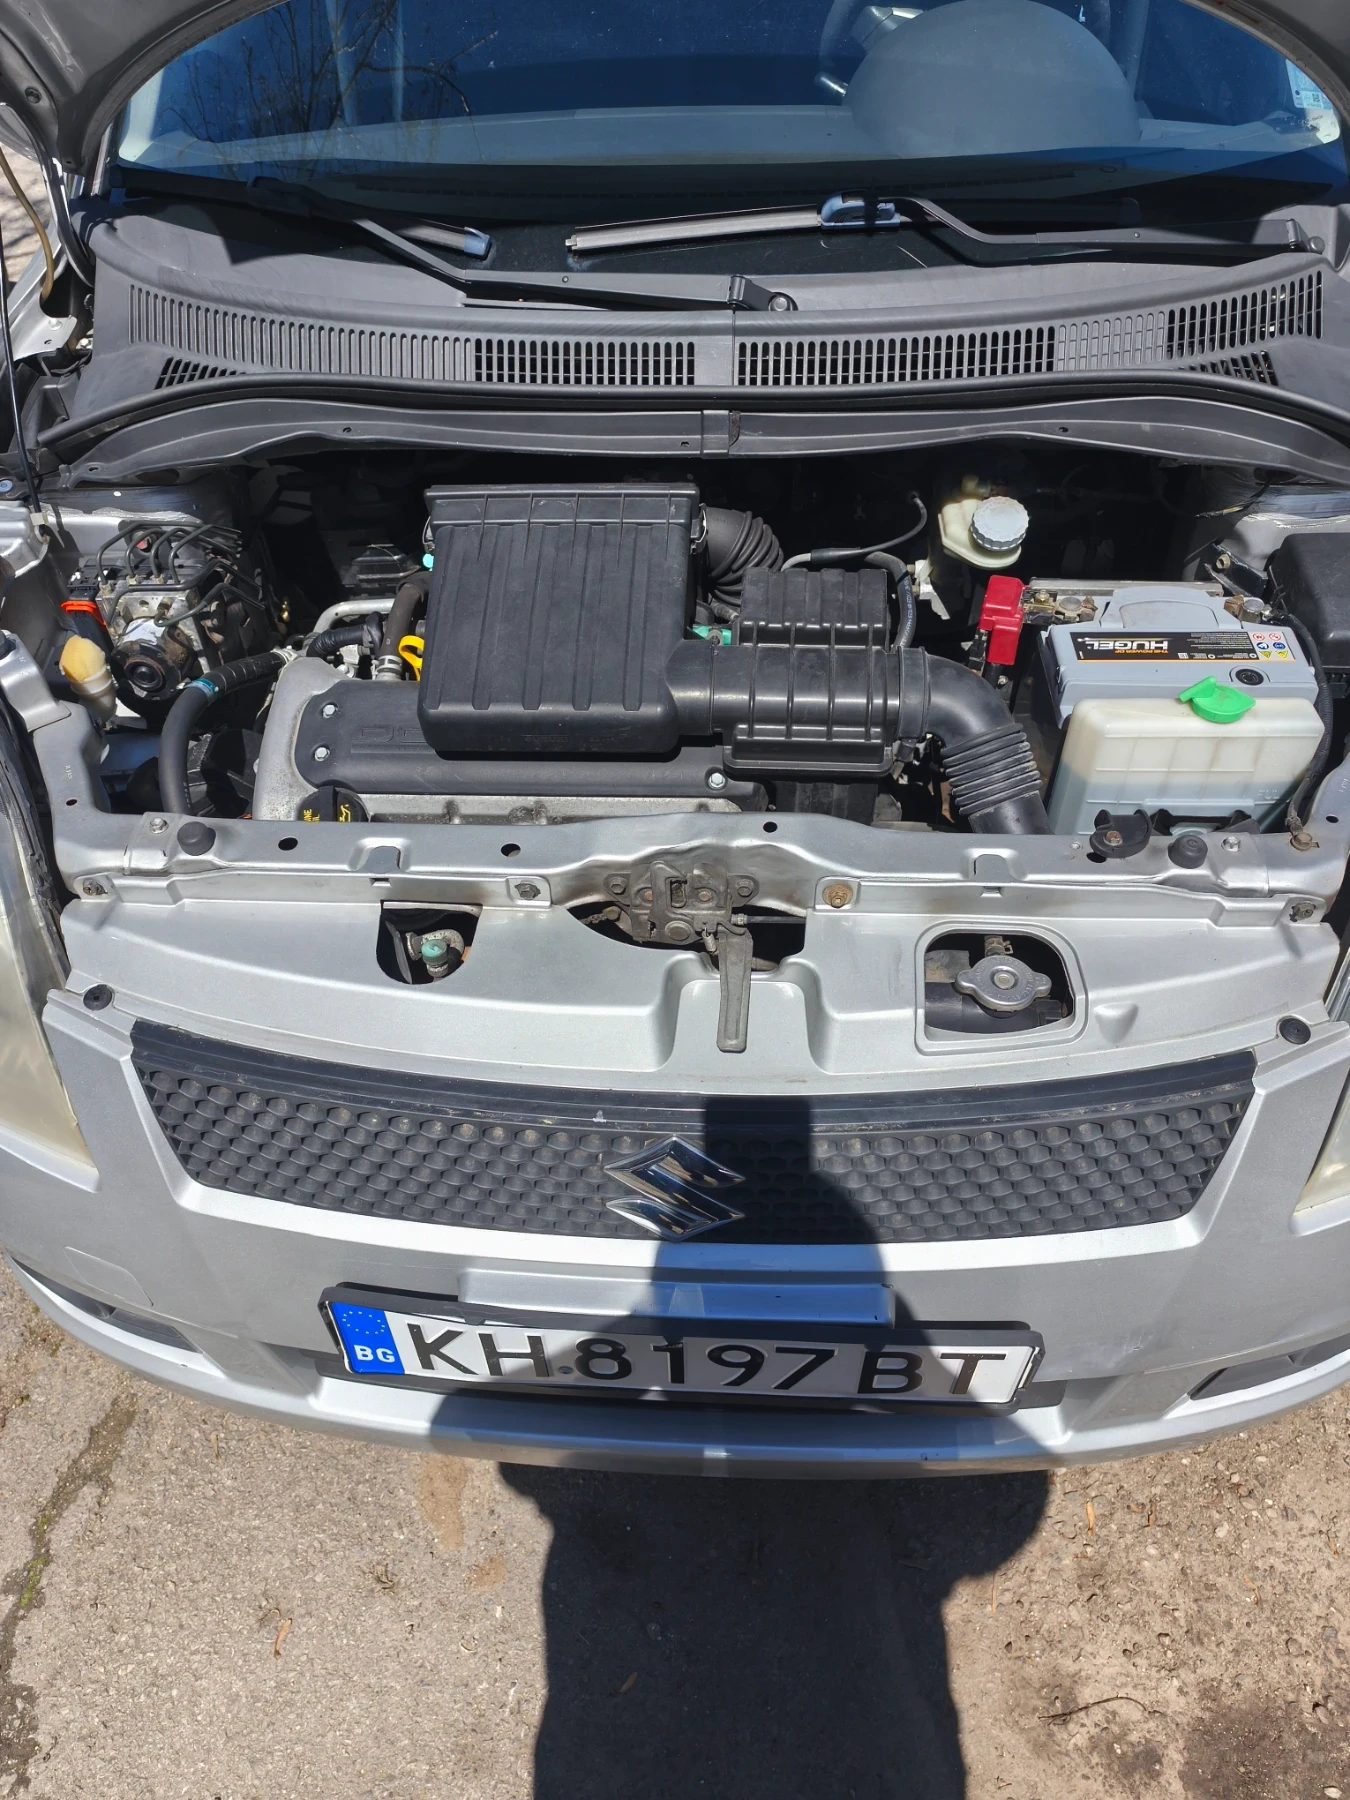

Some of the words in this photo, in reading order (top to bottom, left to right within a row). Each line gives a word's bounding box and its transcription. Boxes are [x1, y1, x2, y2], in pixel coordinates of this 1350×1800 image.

[1085, 641, 1168, 650] HUGEL
[354, 1344, 395, 1364] BG
[406, 1322, 553, 1378] KH
[574, 1337, 838, 1391] 8197
[857, 1350, 1007, 1395] BT
